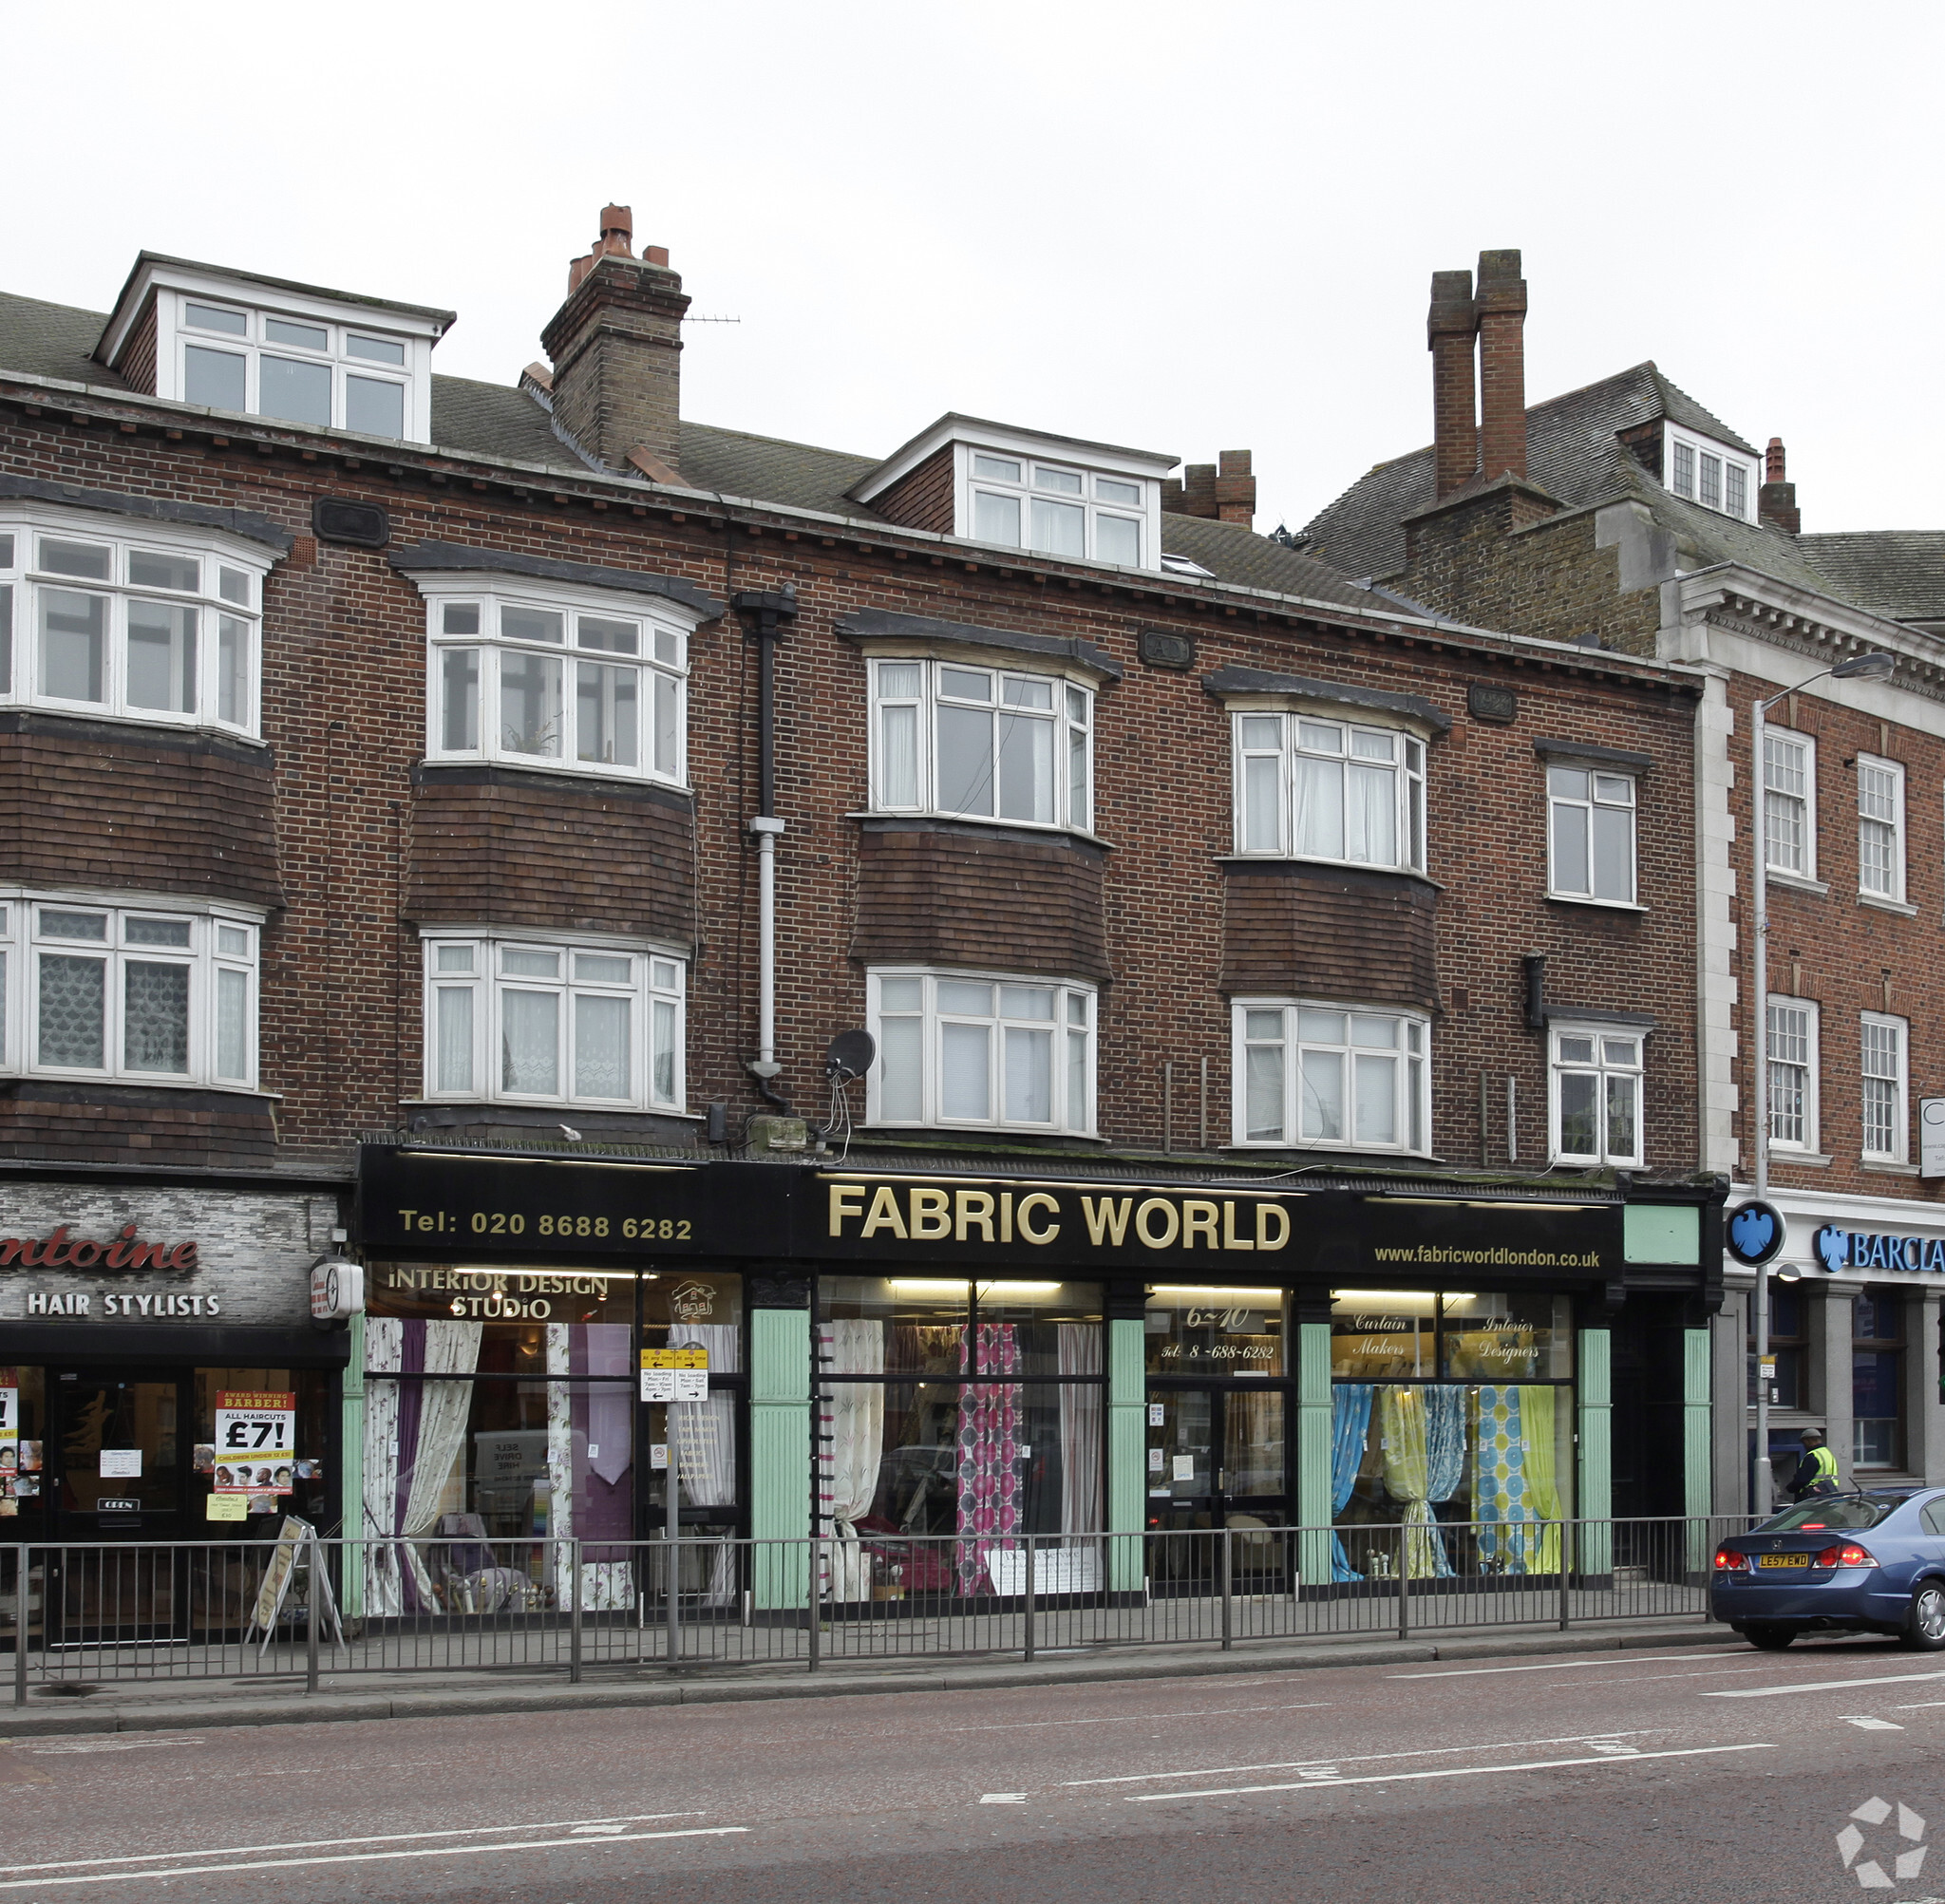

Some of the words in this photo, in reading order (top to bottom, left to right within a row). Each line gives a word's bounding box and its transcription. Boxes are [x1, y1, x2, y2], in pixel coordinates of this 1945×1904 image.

[398, 1209, 457, 1233] Tel:
[471, 1212, 525, 1235] 020
[538, 1215, 610, 1237] 8688
[622, 1217, 691, 1240] 6282
[828, 1183, 1061, 1245] FABRIC
[1081, 1196, 1292, 1251] WORLD
[1374, 1244, 1600, 1268] www.fabricworldlondon.co.uk
[28, 1292, 90, 1315] HAIR
[104, 1293, 220, 1316] STYLISTS
[1352, 1313, 1407, 1330] Curtain
[1482, 1315, 1535, 1333] Interior
[1161, 1345, 1180, 1358] Tel:
[1352, 1337, 1406, 1355] Makers
[1479, 1340, 1539, 1365] Designers
[224, 1398, 287, 1408] BARBER!
[226, 1421, 285, 1448] £7!
[1760, 1555, 1785, 1567] LE57
[1788, 1555, 1807, 1565] EWD
